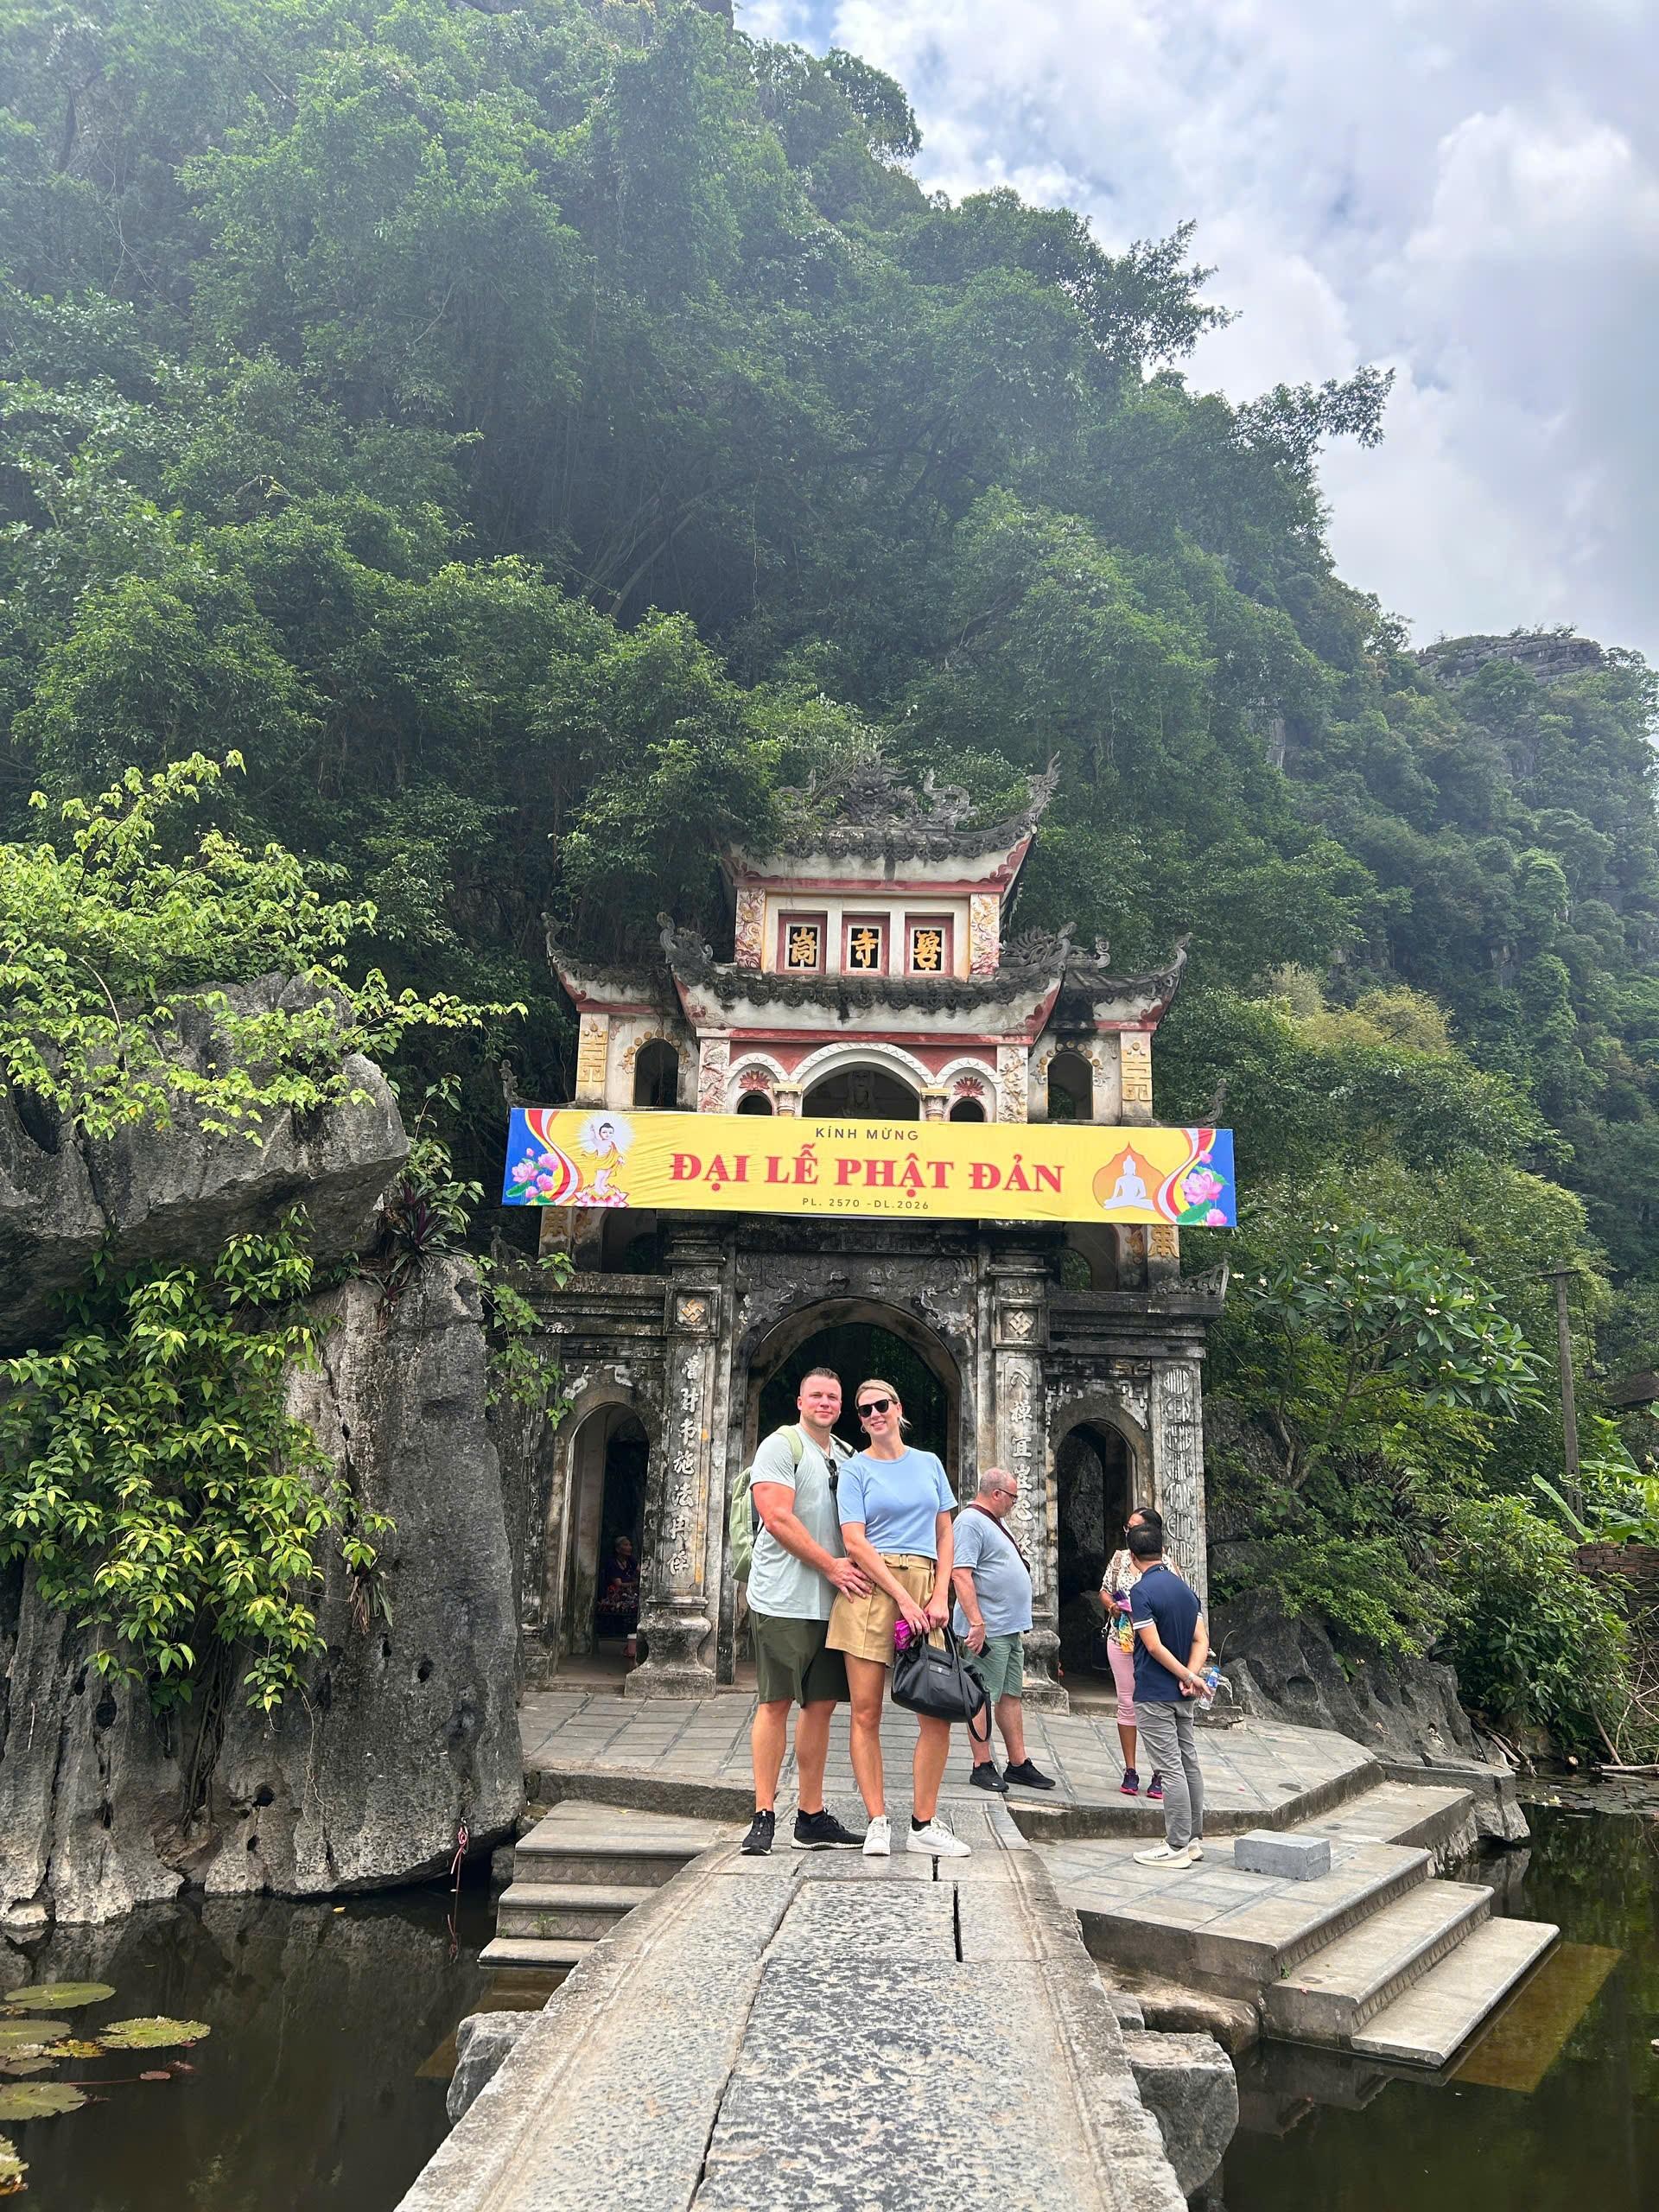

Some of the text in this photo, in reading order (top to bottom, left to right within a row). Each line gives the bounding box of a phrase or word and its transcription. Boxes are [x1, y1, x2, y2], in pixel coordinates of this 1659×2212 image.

[816, 1126, 918, 1141] KÍNH MỪNG
[669, 1142, 1065, 1198] ĐẠI LỄ PHẬT ĐẢN
[802, 1198, 823, 1206] PL.
[829, 1198, 860, 1207] 2570
